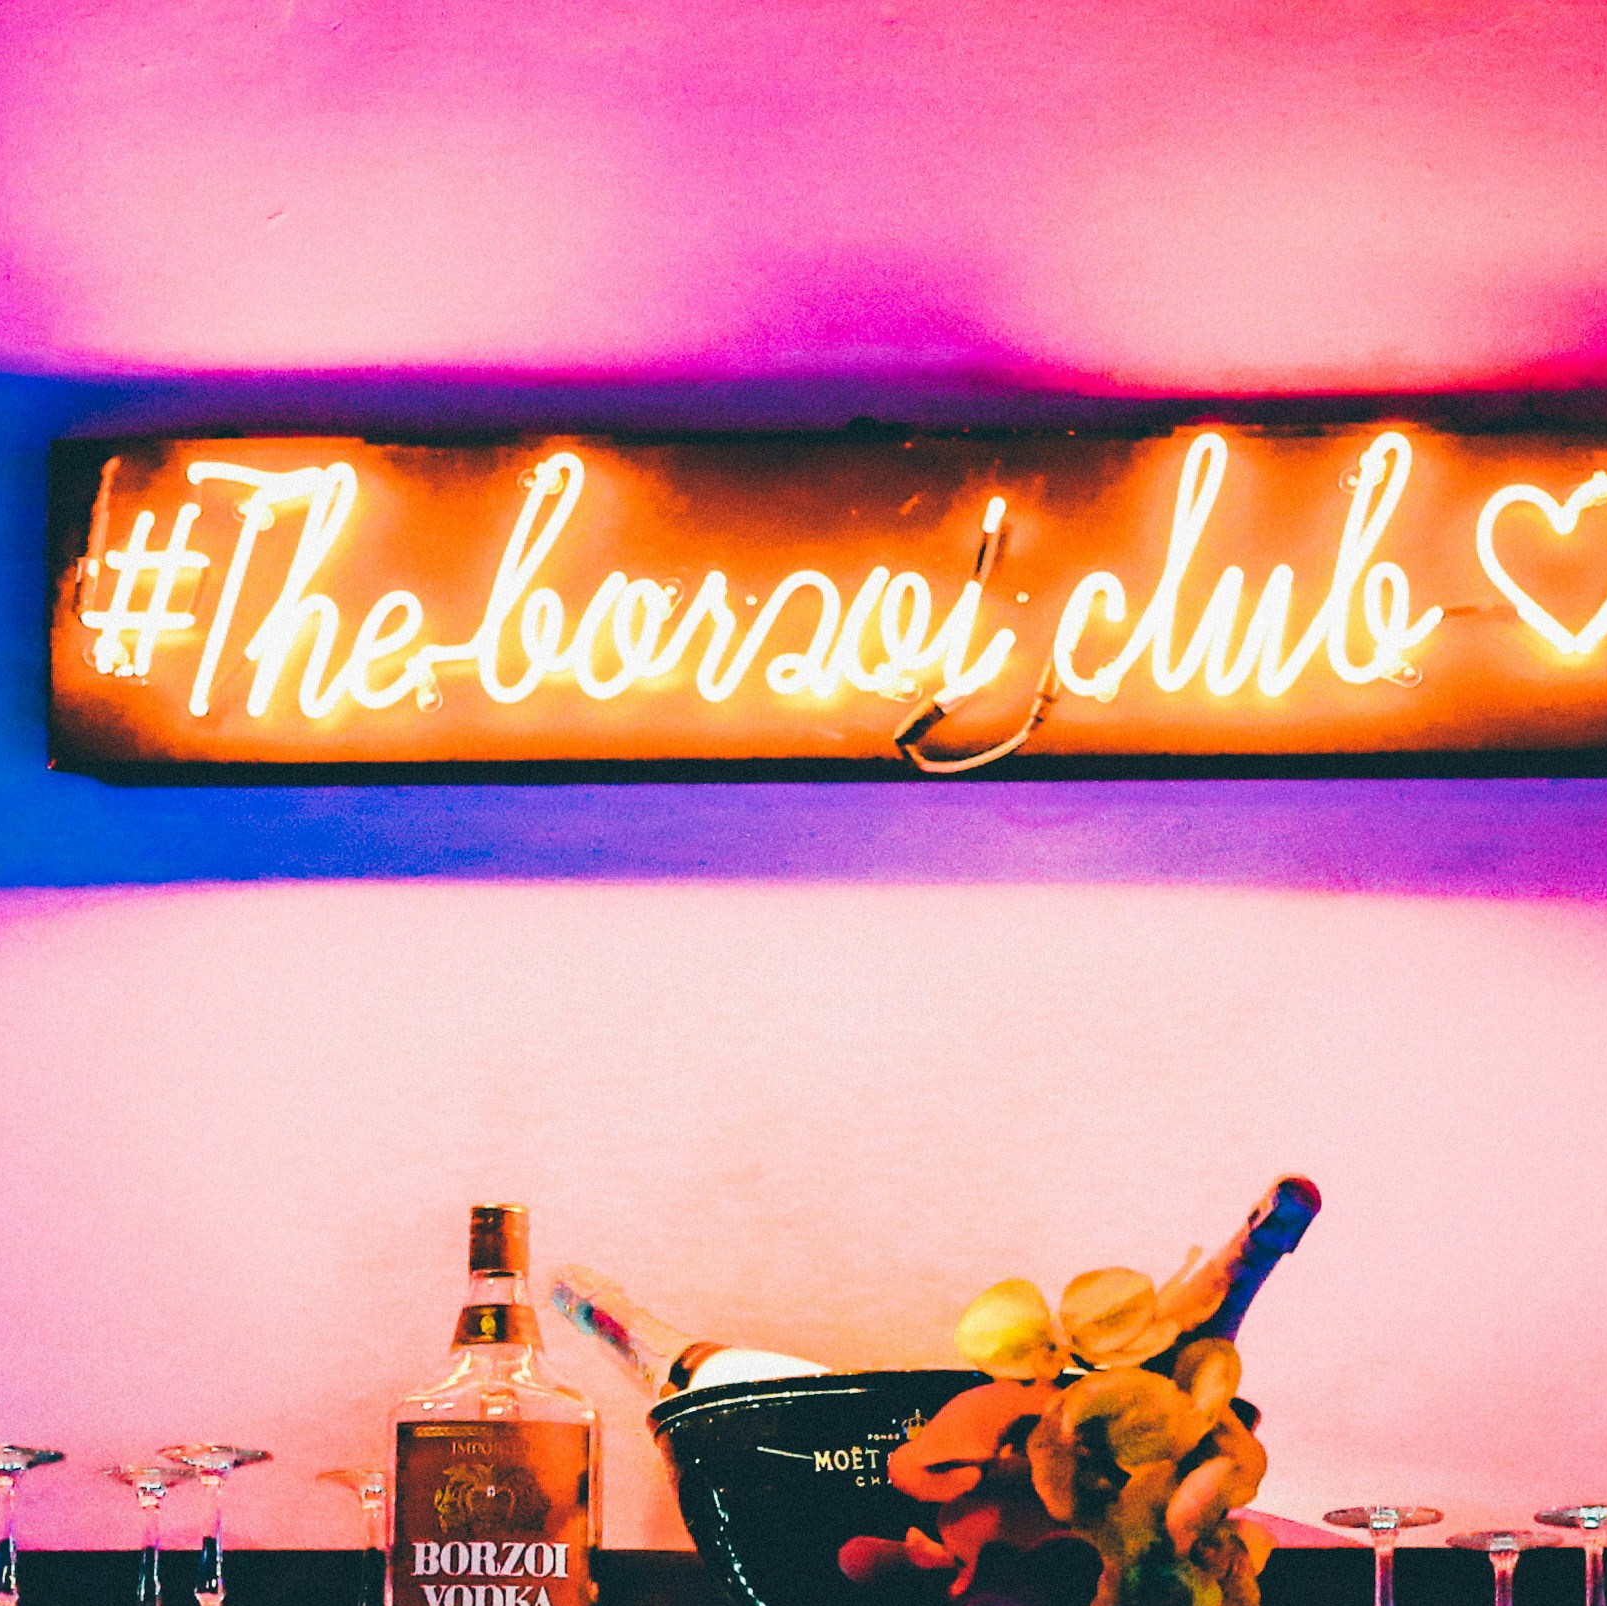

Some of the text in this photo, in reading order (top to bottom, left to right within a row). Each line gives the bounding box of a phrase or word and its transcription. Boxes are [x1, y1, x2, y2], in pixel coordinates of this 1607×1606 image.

[81, 460, 428, 719] #The
[1054, 431, 1445, 697] club
[411, 1541, 570, 1578] BORZOI
